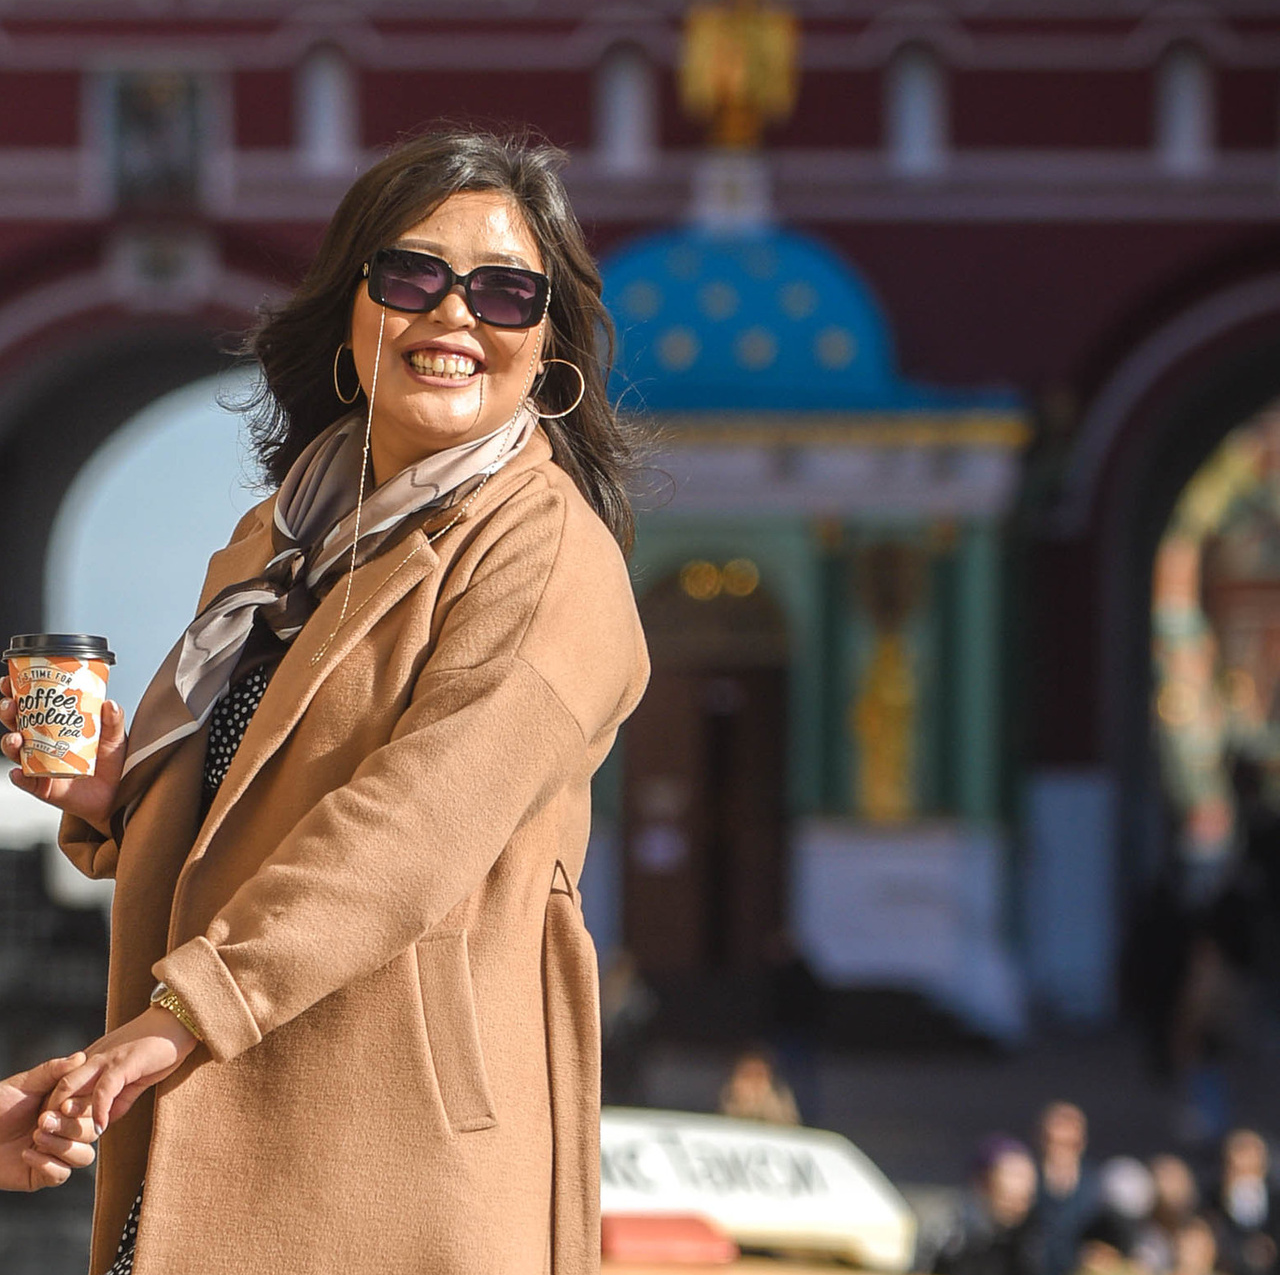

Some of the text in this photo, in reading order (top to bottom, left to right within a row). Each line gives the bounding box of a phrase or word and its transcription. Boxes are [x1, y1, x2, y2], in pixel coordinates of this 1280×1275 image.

[31, 670, 52, 679] TIME
[55, 673, 73, 685] FOR
[18, 688, 76, 712] coffee
[58, 726, 81, 737] tea
